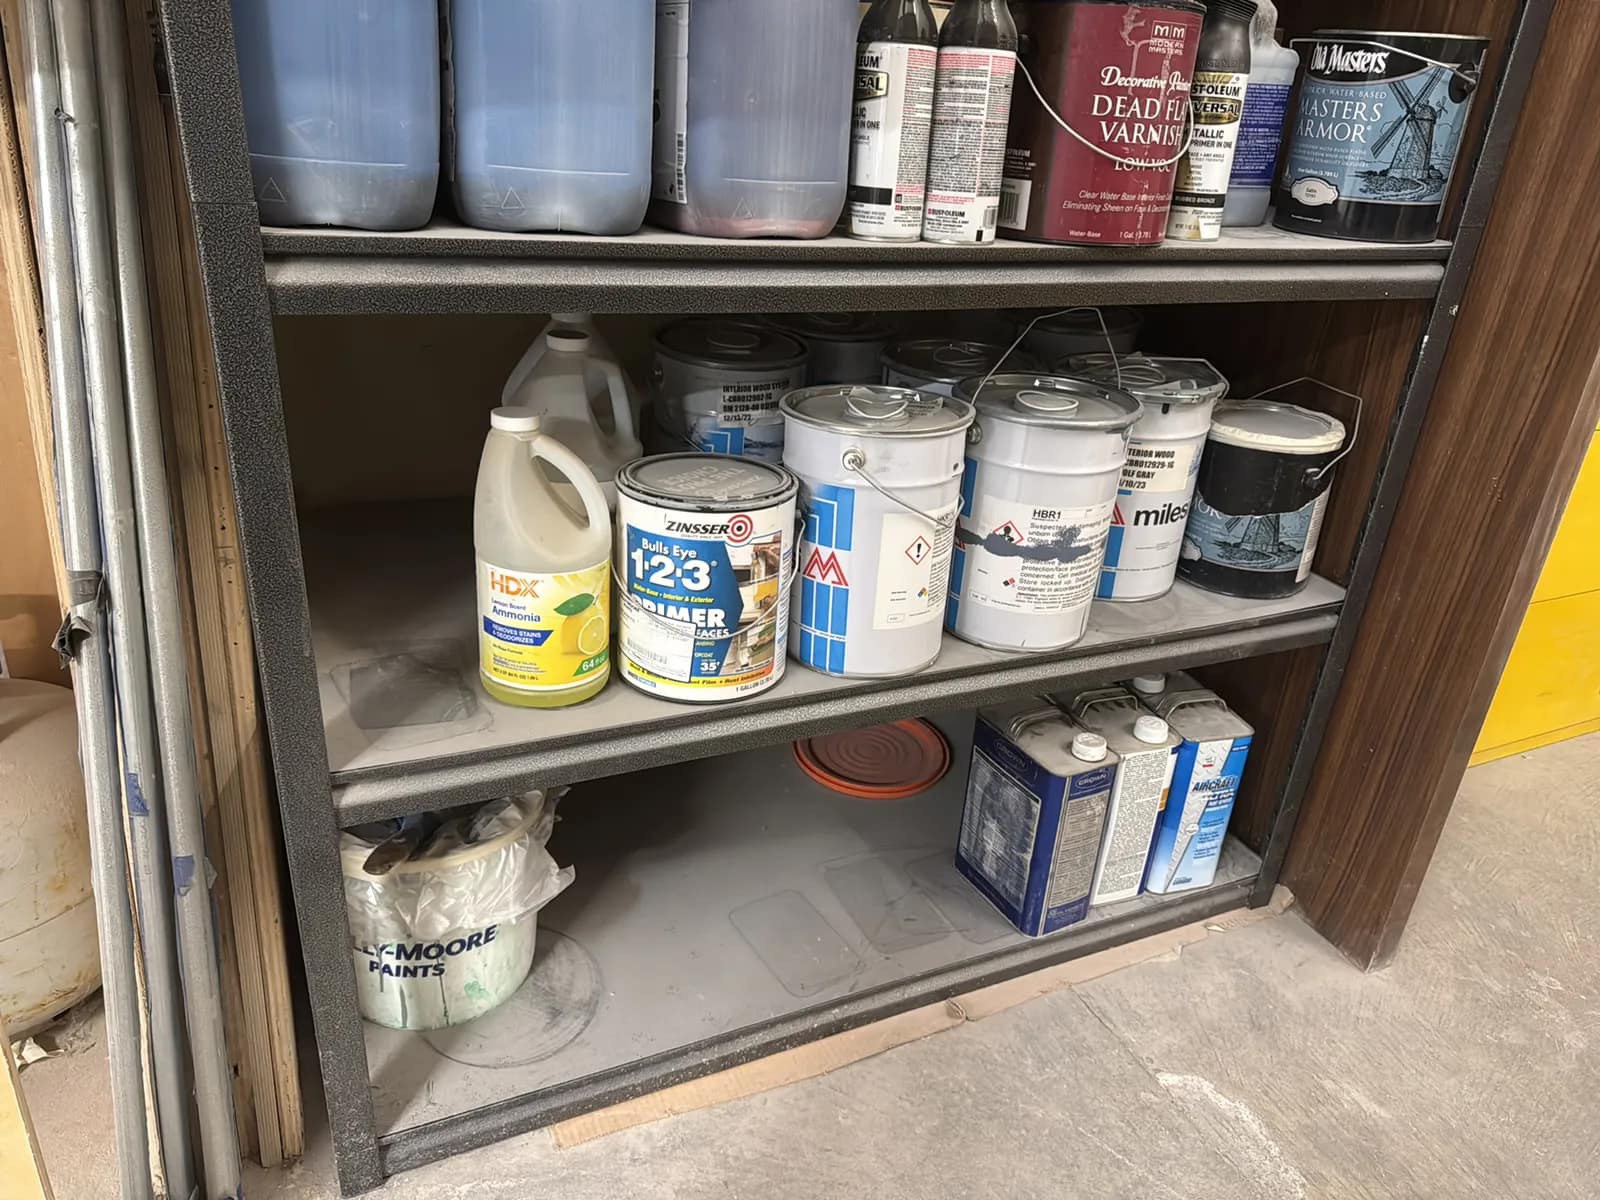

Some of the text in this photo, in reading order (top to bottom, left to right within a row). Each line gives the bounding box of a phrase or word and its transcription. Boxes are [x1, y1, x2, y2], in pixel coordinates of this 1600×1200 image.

[1310, 42, 1391, 75] Old Masters
[1100, 66, 1167, 90] Decorative
[1091, 94, 1162, 120] DEAD
[1099, 120, 1184, 147] VARNISH
[1296, 119, 1367, 144] ARMOR
[1079, 190, 1100, 200] Clear
[1099, 191, 1121, 201] Water
[1062, 200, 1102, 214] Eliminating
[1102, 202, 1124, 213] Sheen
[1032, 508, 1063, 520] HBR1
[665, 520, 730, 535] ZINSSER
[641, 537, 697, 560] Bulls Eye
[490, 571, 540, 599] HDX
[491, 605, 542, 623] Ammonia
[582, 659, 595, 671] 64
[1077, 773, 1108, 787] CROWN
[368, 960, 446, 979] PAINTS
